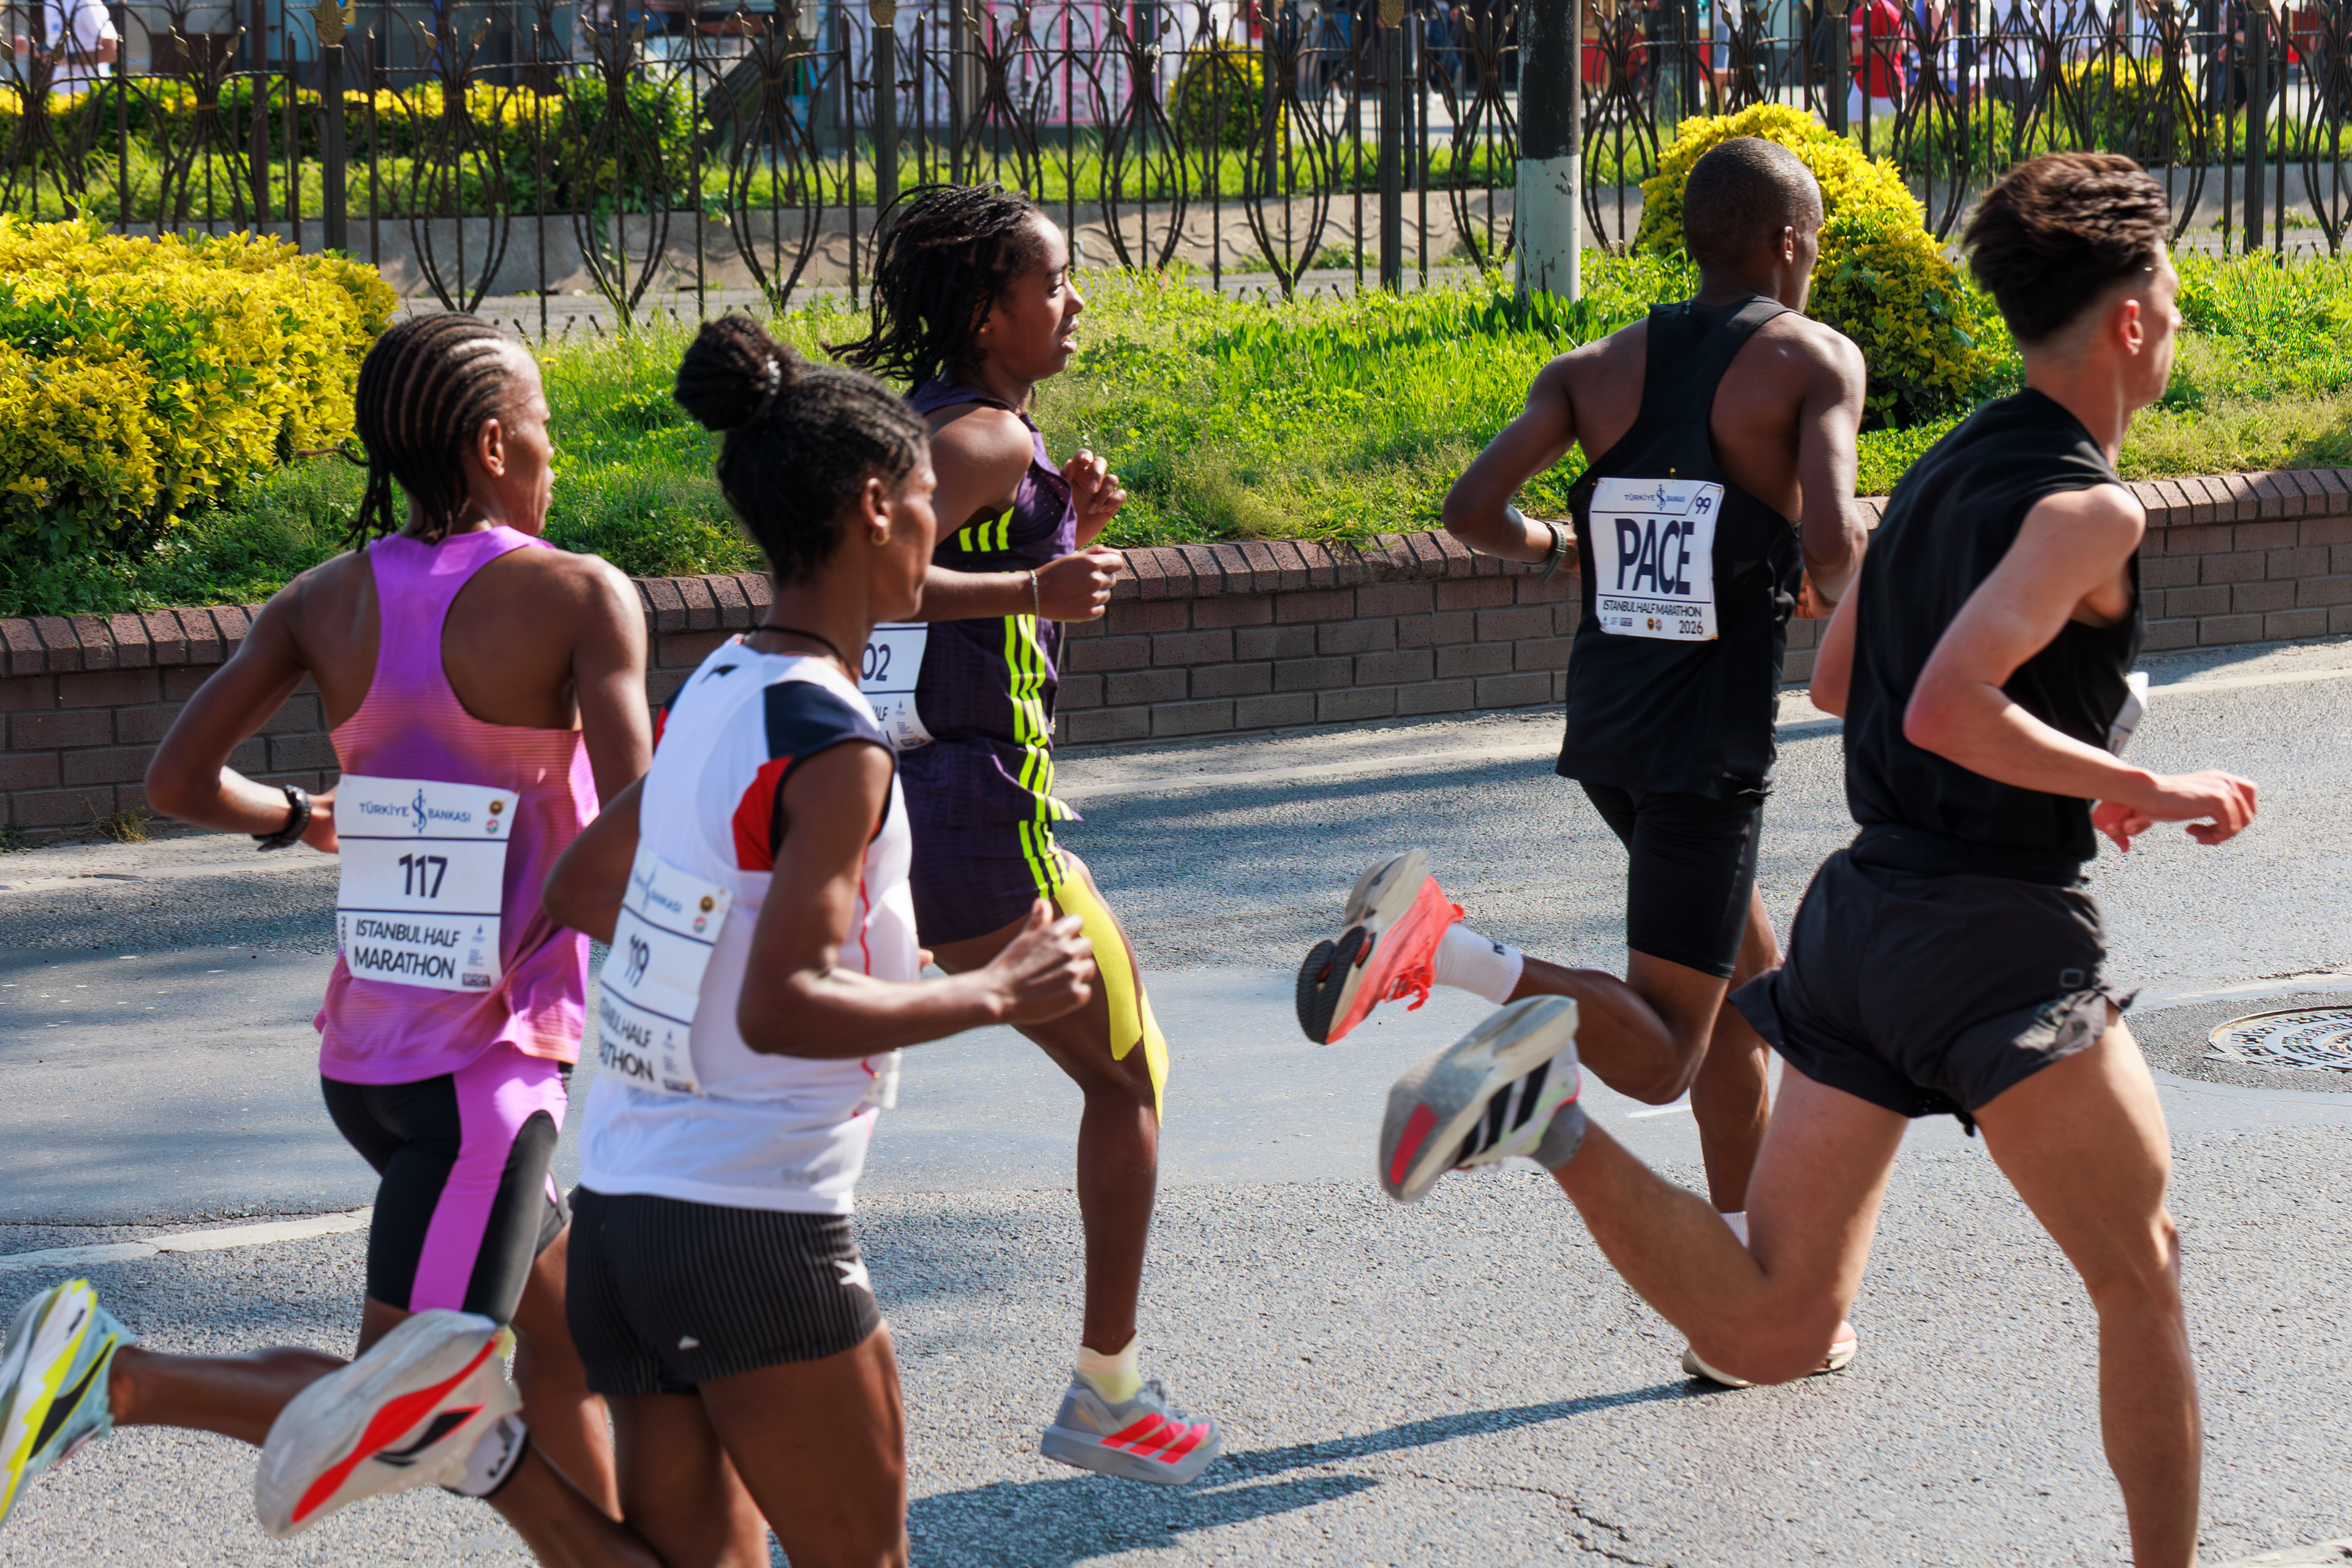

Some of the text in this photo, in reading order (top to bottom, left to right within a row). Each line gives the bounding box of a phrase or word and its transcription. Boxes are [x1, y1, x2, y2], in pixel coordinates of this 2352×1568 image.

[1695, 497, 1711, 514] 99
[1615, 518, 1695, 595] PACE
[1636, 602, 1656, 614] HALF
[1656, 604, 1702, 617] MARATHON
[1679, 620, 1704, 634] 2026
[359, 801, 409, 816] TÜRKİYE
[428, 808, 472, 823] BANKASI
[399, 853, 448, 898] 117
[424, 927, 461, 948] HALF
[354, 946, 455, 979] MARATHON
